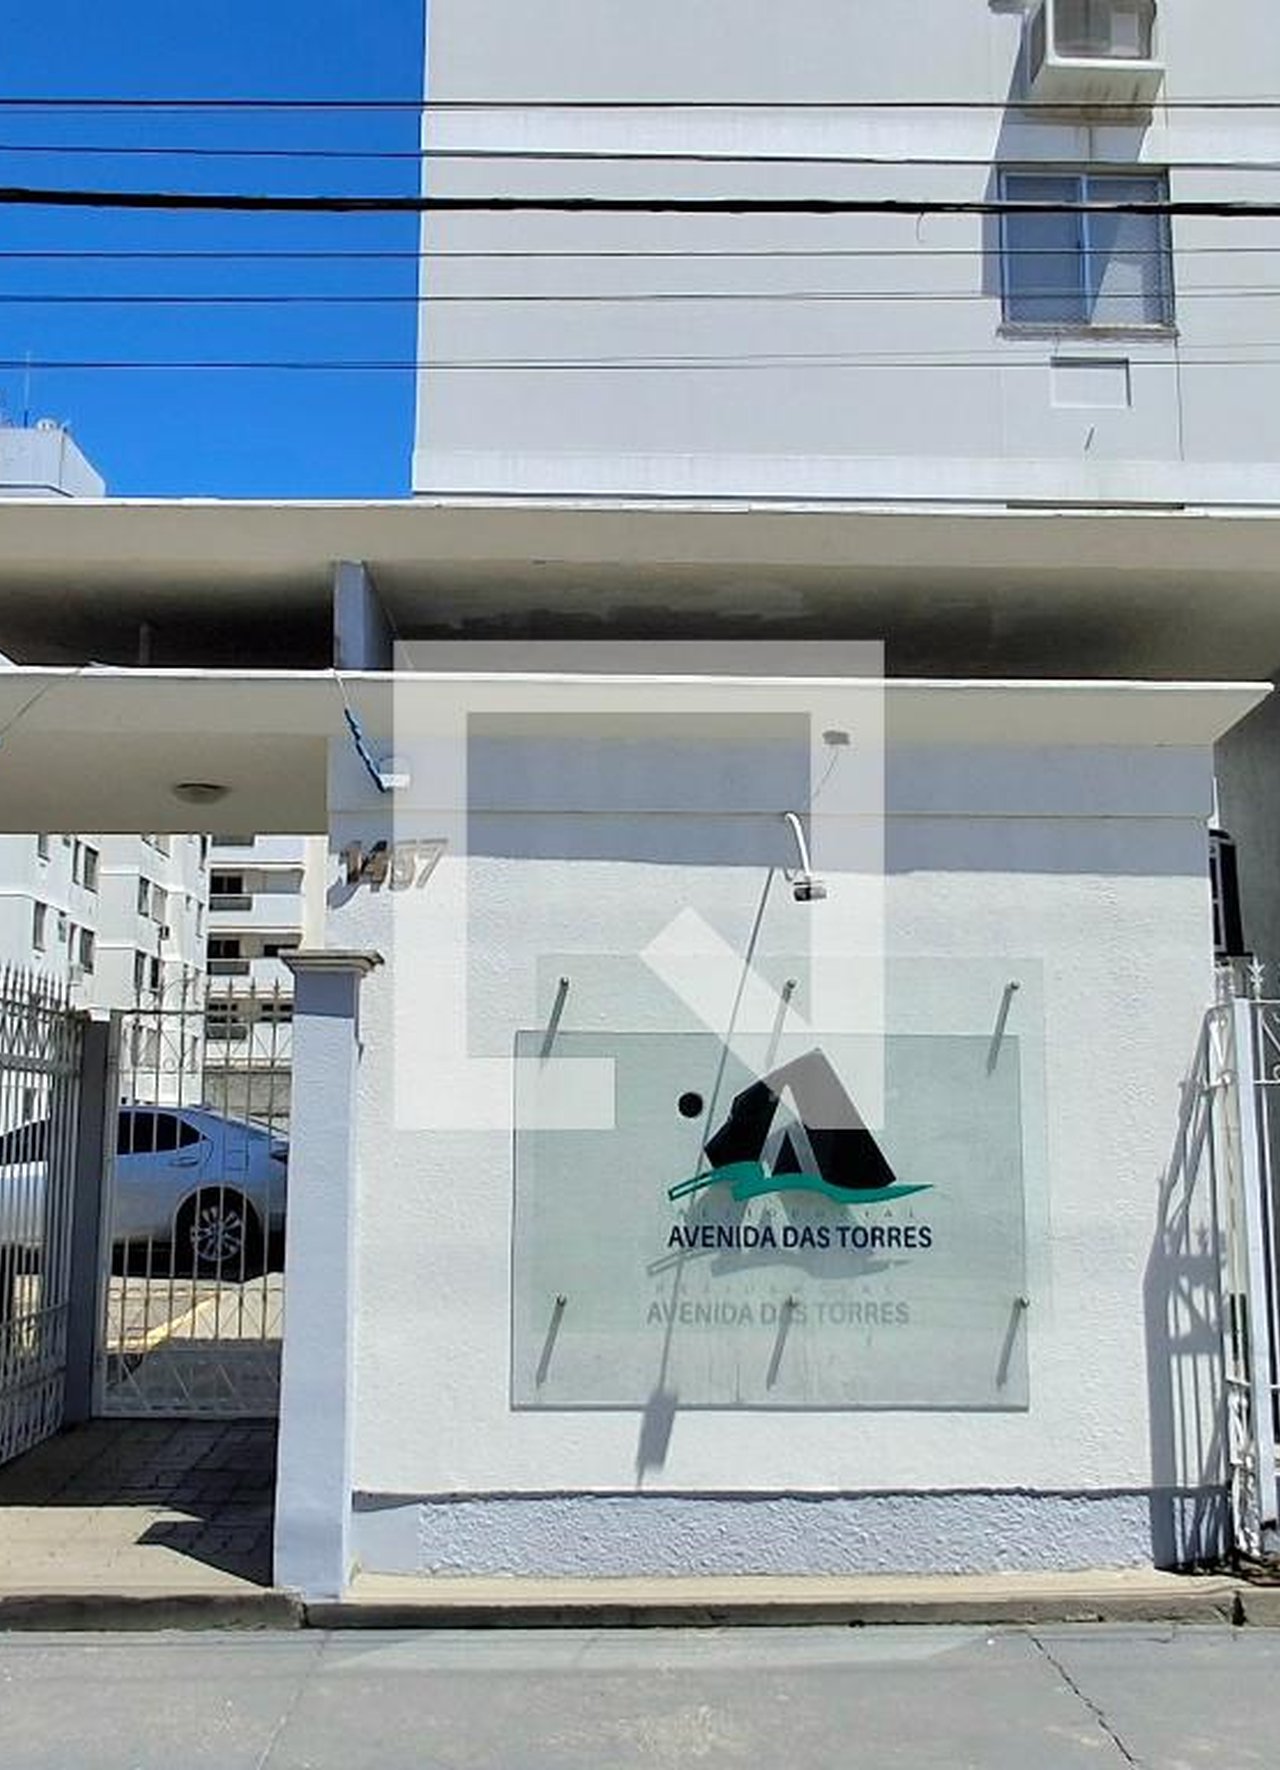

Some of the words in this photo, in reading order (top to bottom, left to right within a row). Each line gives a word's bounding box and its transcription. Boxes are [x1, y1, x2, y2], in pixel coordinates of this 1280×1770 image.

[668, 1225, 776, 1249] AVENIDA
[782, 1225, 830, 1249] DAS
[836, 1225, 933, 1249] TORRES
